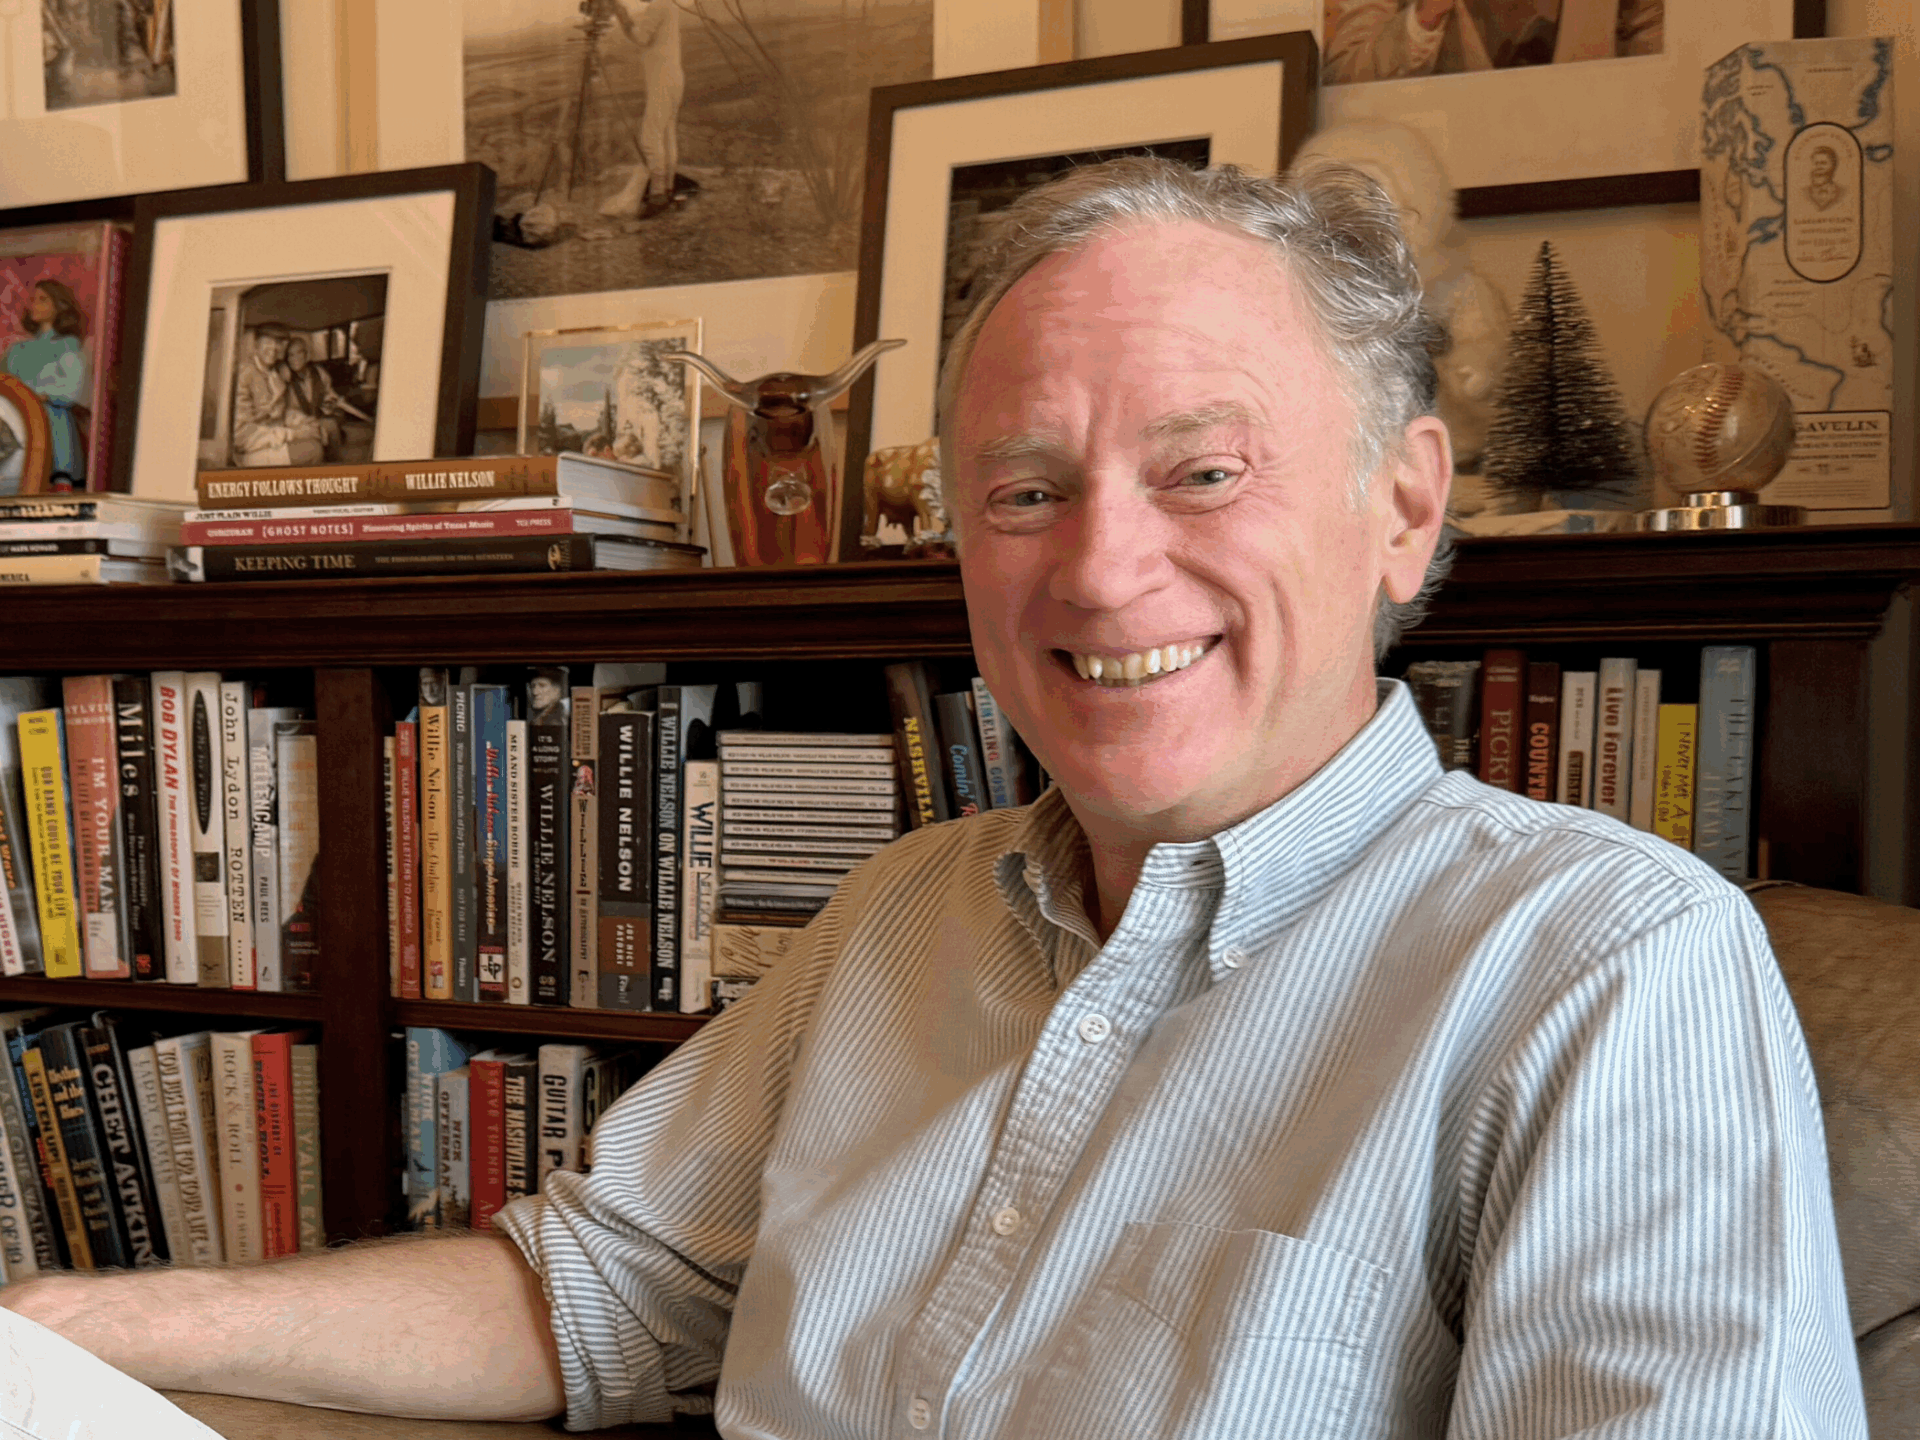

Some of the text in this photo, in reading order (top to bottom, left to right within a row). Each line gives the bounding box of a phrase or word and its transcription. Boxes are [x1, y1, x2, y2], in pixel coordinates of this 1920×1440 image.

[207, 476, 359, 499] ENERGY FOLLOWS THOUGHT
[405, 469, 496, 490] WILLIE NELSON
[243, 510, 272, 519] WILLIE
[235, 554, 357, 572] KEEPING TIME
[160, 686, 180, 790] BOB DYLAN
[456, 691, 466, 733] PICNIC
[1728, 699, 1747, 736] THE
[118, 703, 146, 797] Miles
[222, 692, 241, 820] John Lydon
[426, 714, 441, 820] Willie Nelson
[904, 717, 934, 825] NASHVILL
[949, 745, 975, 800] Comin'
[1454, 738, 1469, 763] THE
[1528, 722, 1550, 802] COUNTR
[1601, 687, 1623, 807] Live Forever
[1676, 731, 1692, 770] Never
[250, 746, 272, 858] MELLENCAMP
[400, 767, 410, 796] WILLIE
[509, 734, 520, 868] ME AND SISTER BOBBIE
[1568, 755, 1582, 806] WHISKE
[1674, 772, 1692, 800] Met
[91, 757, 115, 914] I'M YOUR MAN
[540, 784, 554, 865] WILLIE
[618, 725, 633, 892] WILLIE NELSON
[689, 801, 715, 869] WILLIE
[1670, 803, 1690, 820] A
[1701, 771, 1721, 848] JIMMY
[427, 832, 439, 850] The
[657, 716, 677, 970] WILLIE NELSON ON WILLIE NELSON
[230, 847, 245, 924] ROTTEN
[259, 876, 269, 898] PAUL
[403, 882, 411, 896] TO
[533, 857, 541, 884] DAVID
[403, 896, 413, 934] AMERICA
[458, 923, 466, 942] SALE
[541, 871, 556, 963] NELSON
[616, 924, 625, 966] PATOSKI
[626, 923, 634, 968] JOE NICK
[159, 1047, 180, 1078] YOU
[29, 1071, 51, 1134] LISTEN
[223, 1049, 243, 1171] ROCK & ROLL
[487, 1070, 501, 1185] STEVE TURNER
[542, 1074, 567, 1168] GUITAR P
[439, 1091, 451, 1188] OFFERMAN
[452, 1120, 462, 1162] NICK
[505, 1076, 526, 1190] THE NASHVILLE
[91, 1063, 153, 1266] CHET ATKIN
[173, 1149, 196, 1176] FOR
[299, 1131, 316, 1196] Y'ALL
[179, 1177, 203, 1213] YOUR
[25, 1188, 53, 1268] WALKIN
[186, 1214, 210, 1243] LIFE
[300, 1206, 317, 1248] EAT
